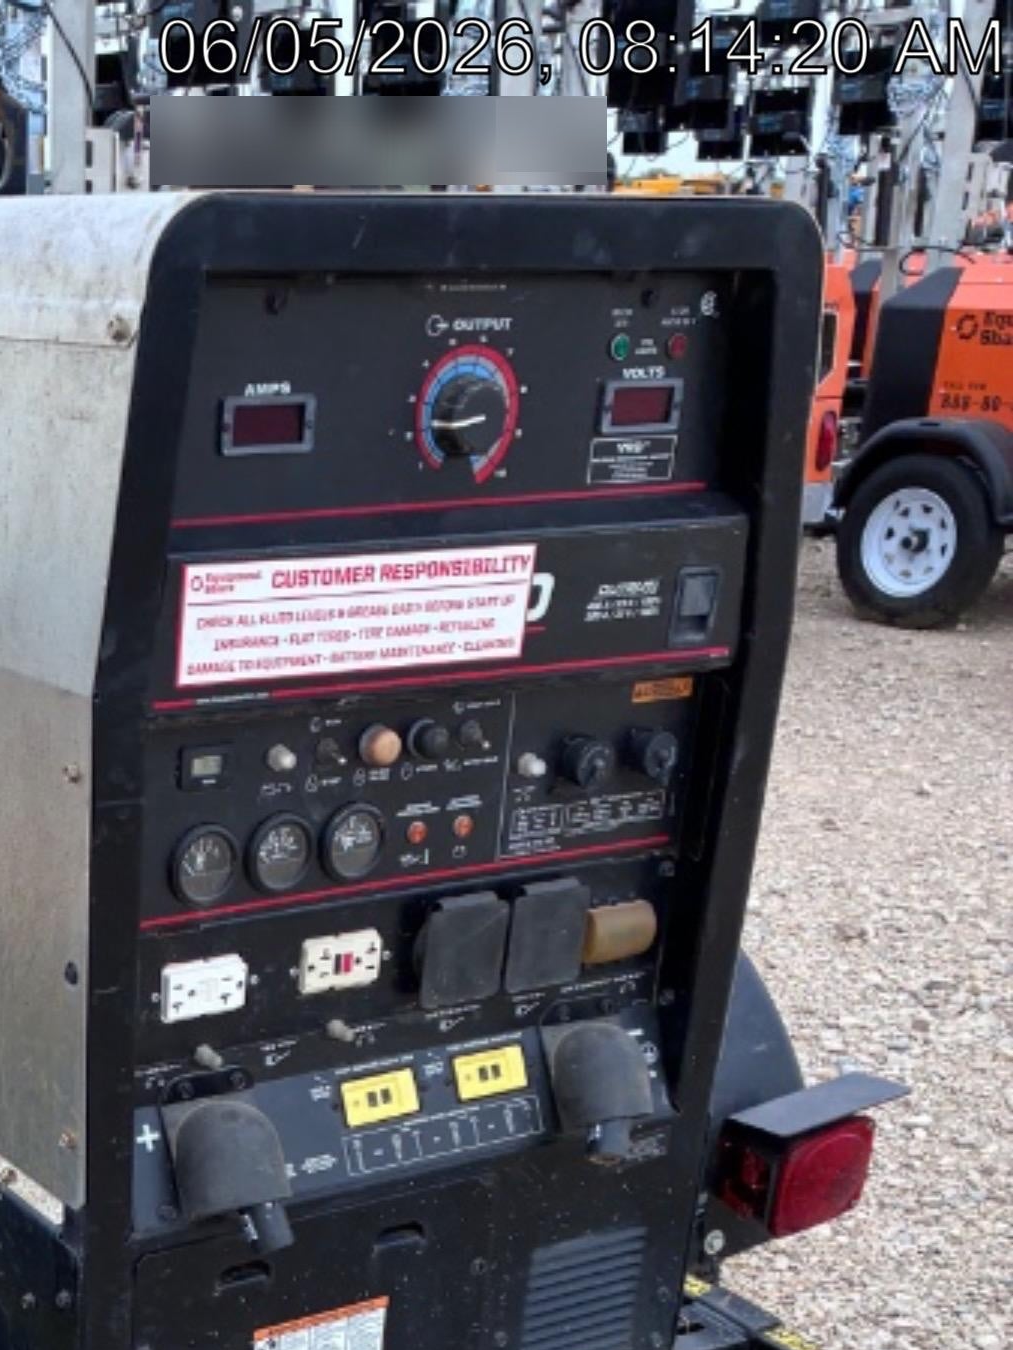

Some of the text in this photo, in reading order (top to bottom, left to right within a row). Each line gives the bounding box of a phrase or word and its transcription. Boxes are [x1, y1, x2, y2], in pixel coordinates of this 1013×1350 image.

[452, 317, 513, 331] OUTPUT
[622, 365, 667, 379] VOLTS
[244, 380, 292, 397] AMPS
[270, 566, 376, 590] CUSTOMER
[379, 555, 533, 583] RESPONSIBILITY
